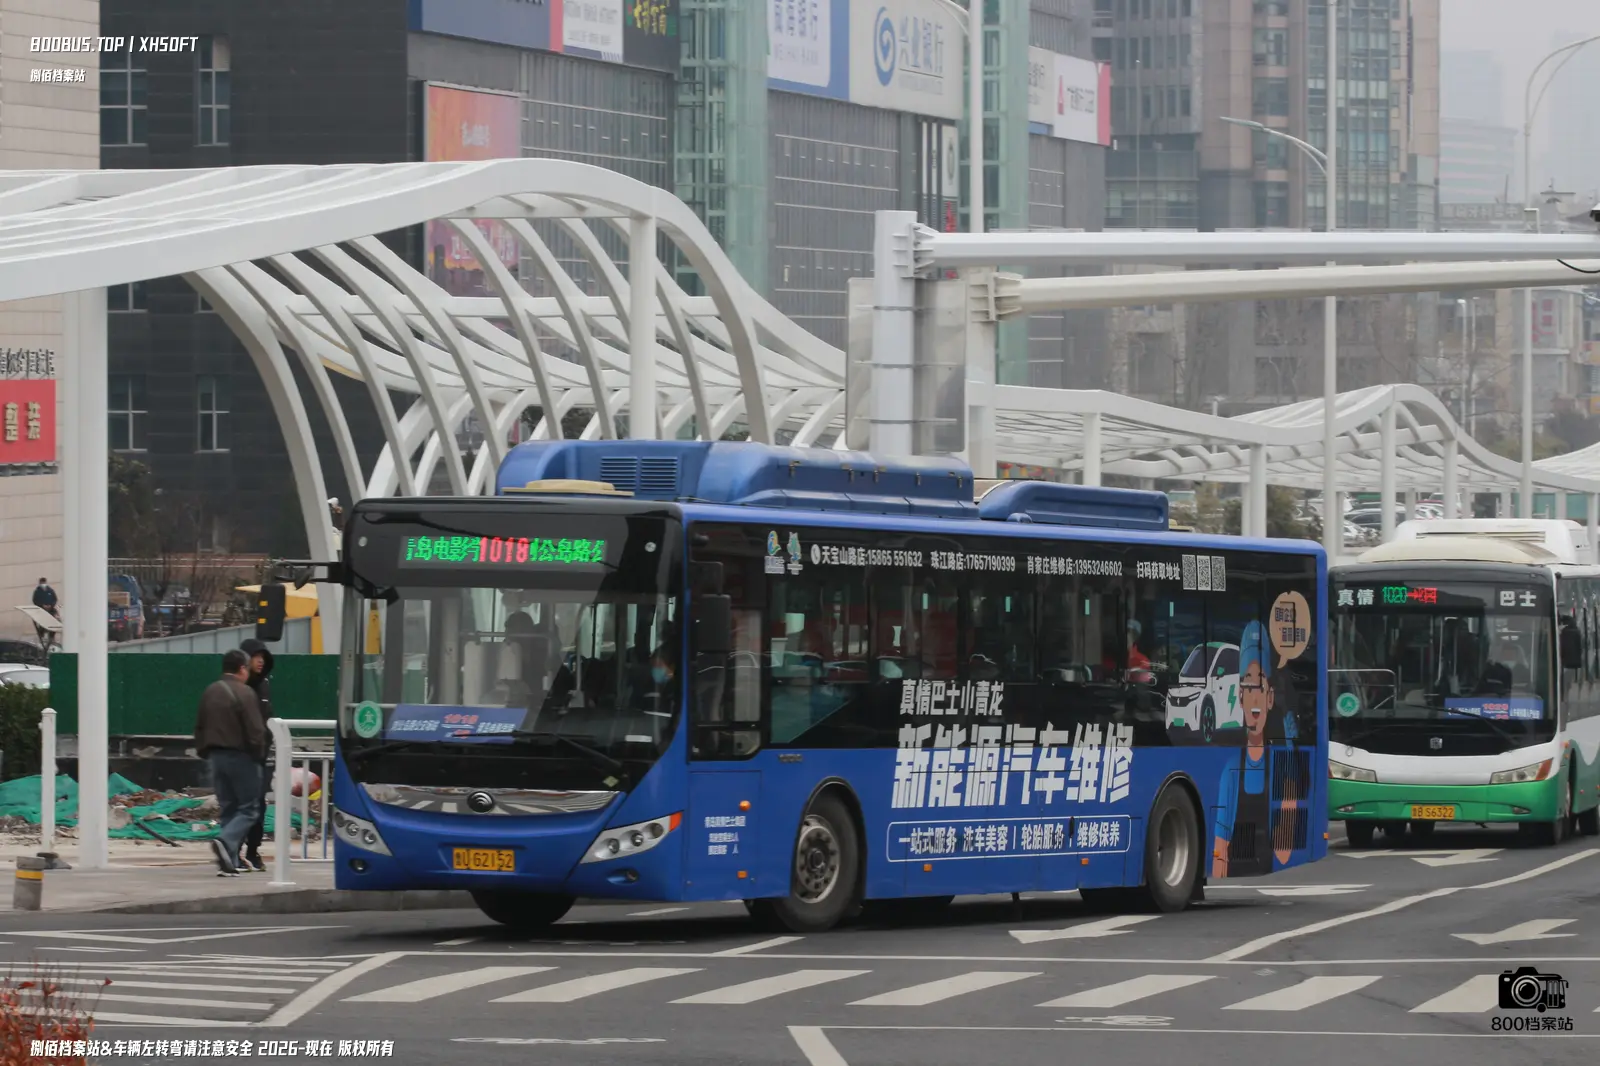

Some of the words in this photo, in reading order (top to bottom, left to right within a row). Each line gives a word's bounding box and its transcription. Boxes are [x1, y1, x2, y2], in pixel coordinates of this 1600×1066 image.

[479, 536, 530, 563] 1018
[1136, 560, 1181, 581] 扫码获取地址
[1337, 589, 1375, 607] 真情
[1500, 590, 1537, 608] 巴士
[900, 679, 1005, 716] 真情巴士小青龙
[891, 721, 1134, 809] 新能源汽车维修
[899, 826, 958, 855] 一站式服务
[963, 825, 1009, 852] 洗车美容
[1021, 822, 1066, 850] 轮胎服务
[1077, 821, 1120, 848] 维修保养
